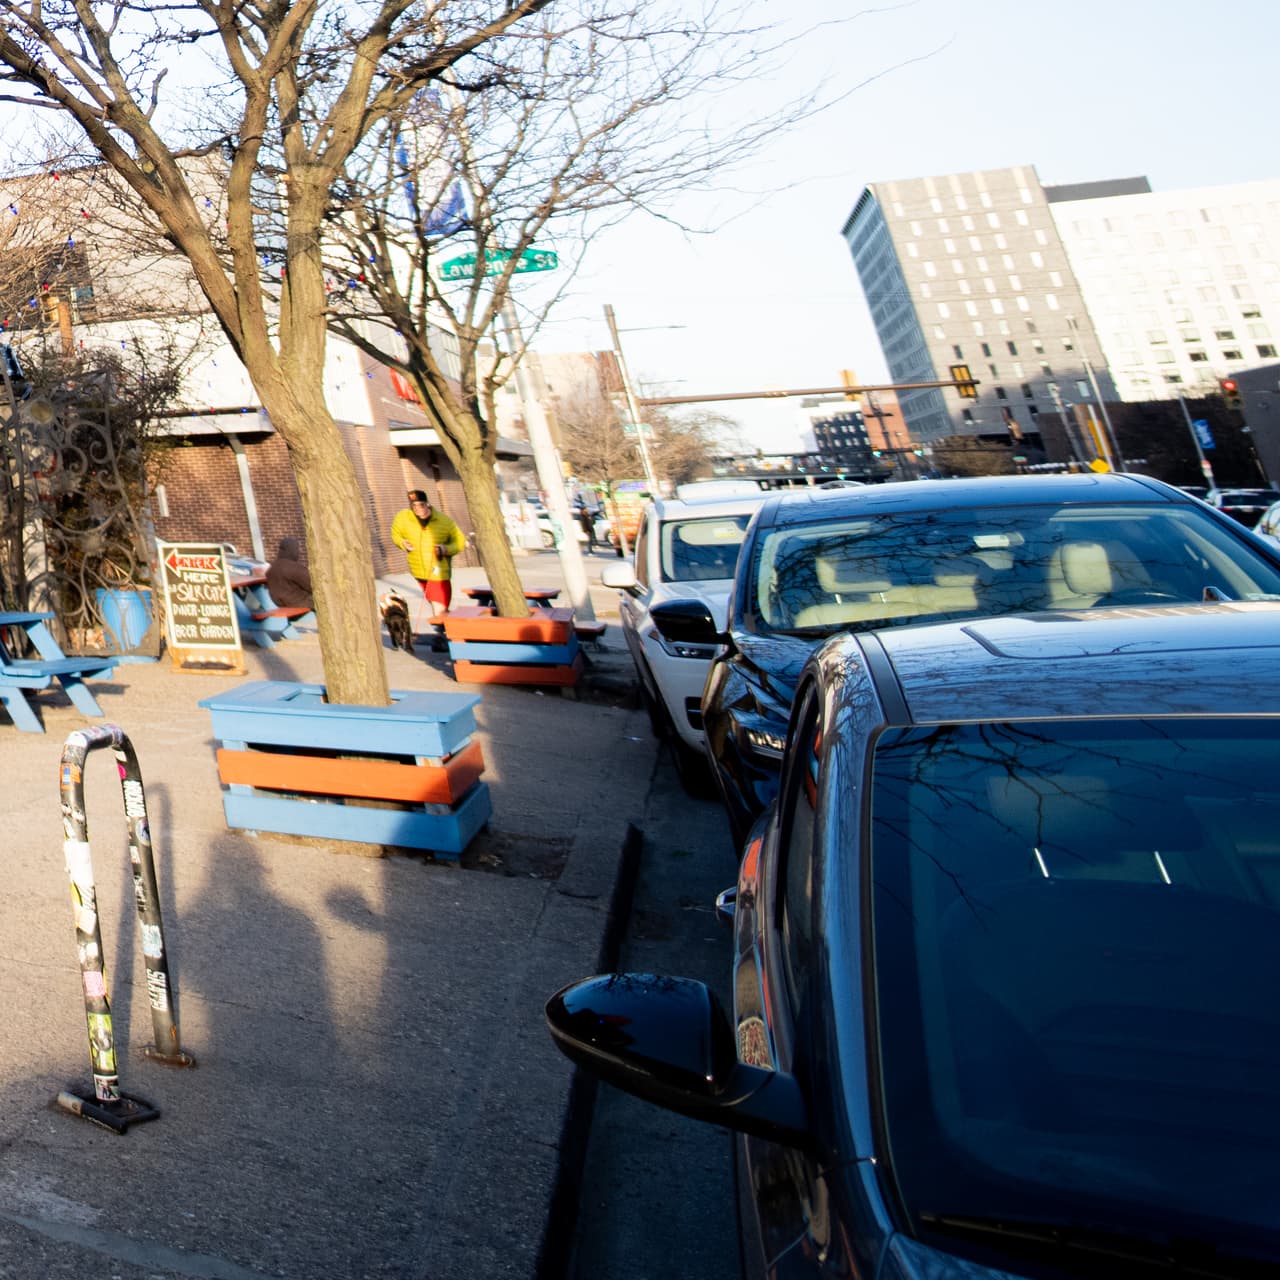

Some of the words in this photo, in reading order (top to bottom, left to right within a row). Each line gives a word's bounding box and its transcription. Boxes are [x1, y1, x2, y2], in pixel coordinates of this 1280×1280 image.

[440, 257, 528, 278] Lawene
[535, 253, 556, 269] St
[176, 557, 214, 569] ENTER
[183, 572, 219, 584] HERE
[200, 604, 231, 617] LOUNGE
[175, 624, 198, 638] BEER
[200, 625, 234, 639] GARDEN
